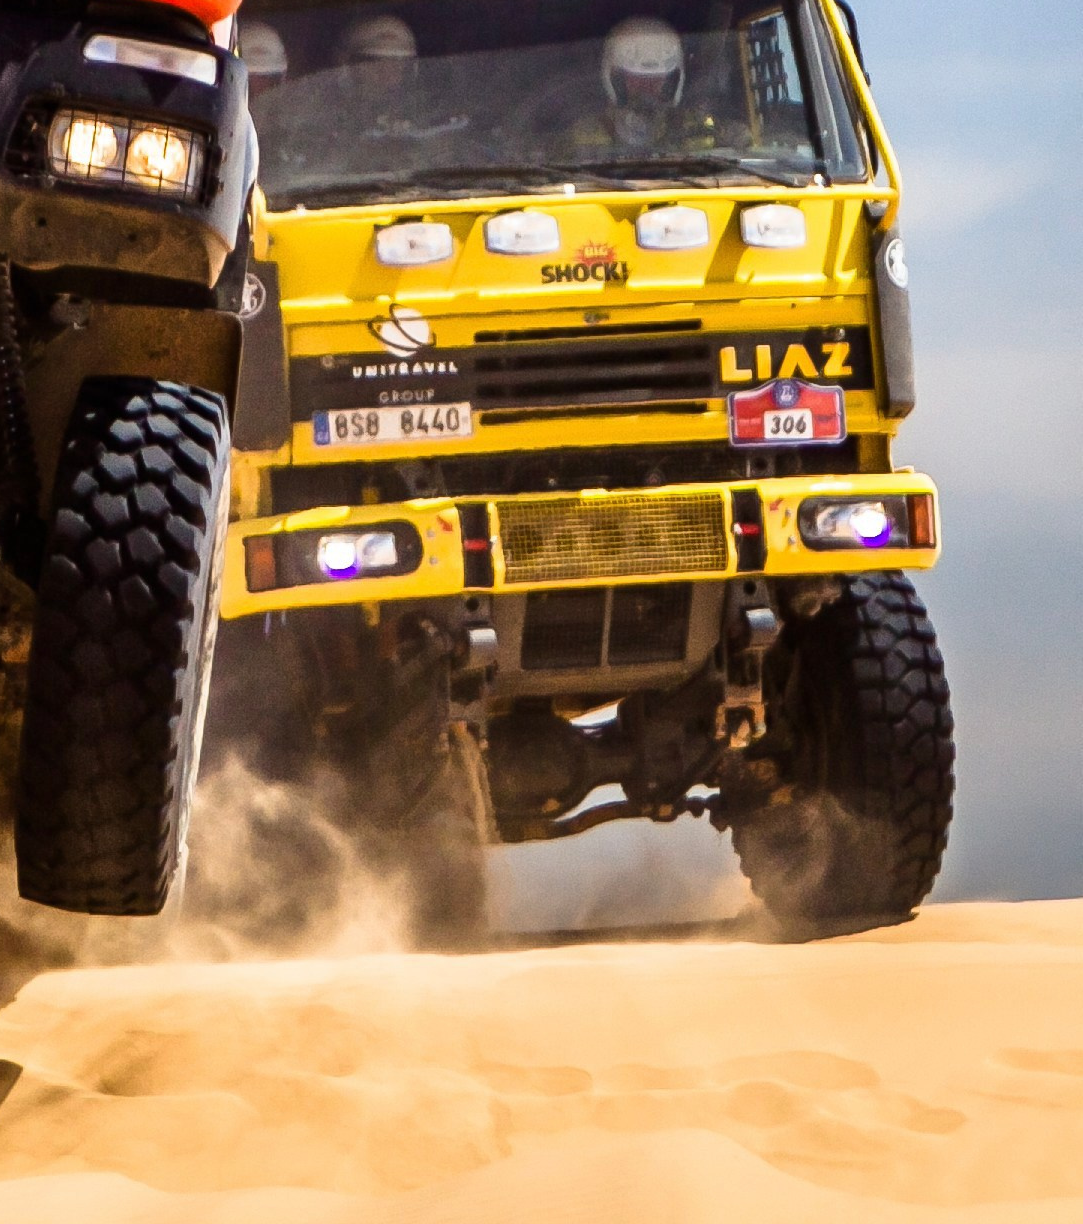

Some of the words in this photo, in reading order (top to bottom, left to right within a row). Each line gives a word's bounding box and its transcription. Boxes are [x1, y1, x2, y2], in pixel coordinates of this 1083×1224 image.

[541, 261, 629, 284] SHOCK!
[352, 360, 459, 377] UNITRAVEL
[378, 388, 435, 404] GROUP
[770, 415, 807, 435] 306
